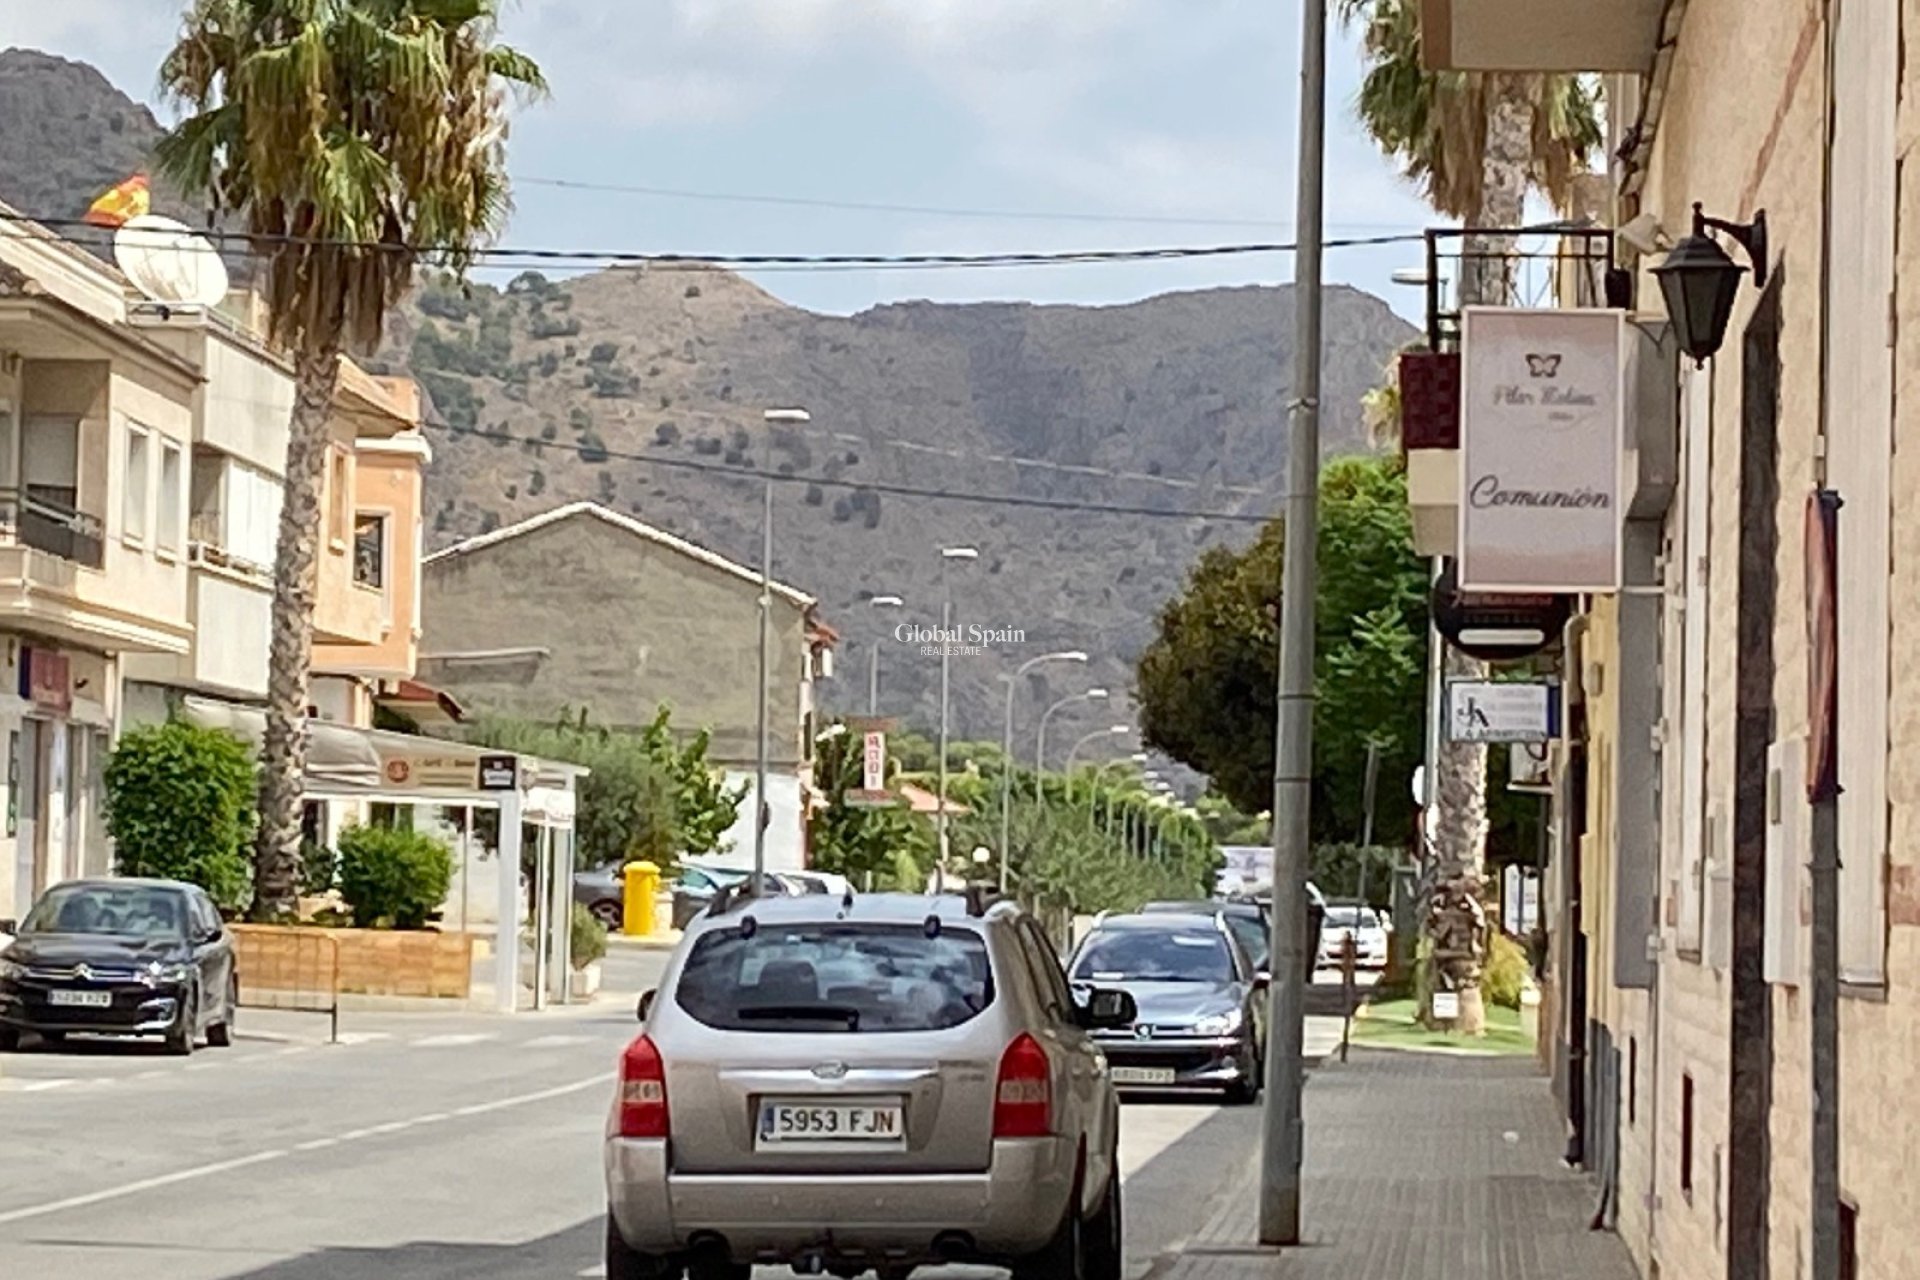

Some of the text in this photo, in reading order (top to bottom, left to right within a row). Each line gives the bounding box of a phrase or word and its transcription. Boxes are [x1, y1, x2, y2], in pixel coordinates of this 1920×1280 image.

[1470, 474, 1608, 508] Comunión
[779, 1108, 894, 1133] 5953 FJN
